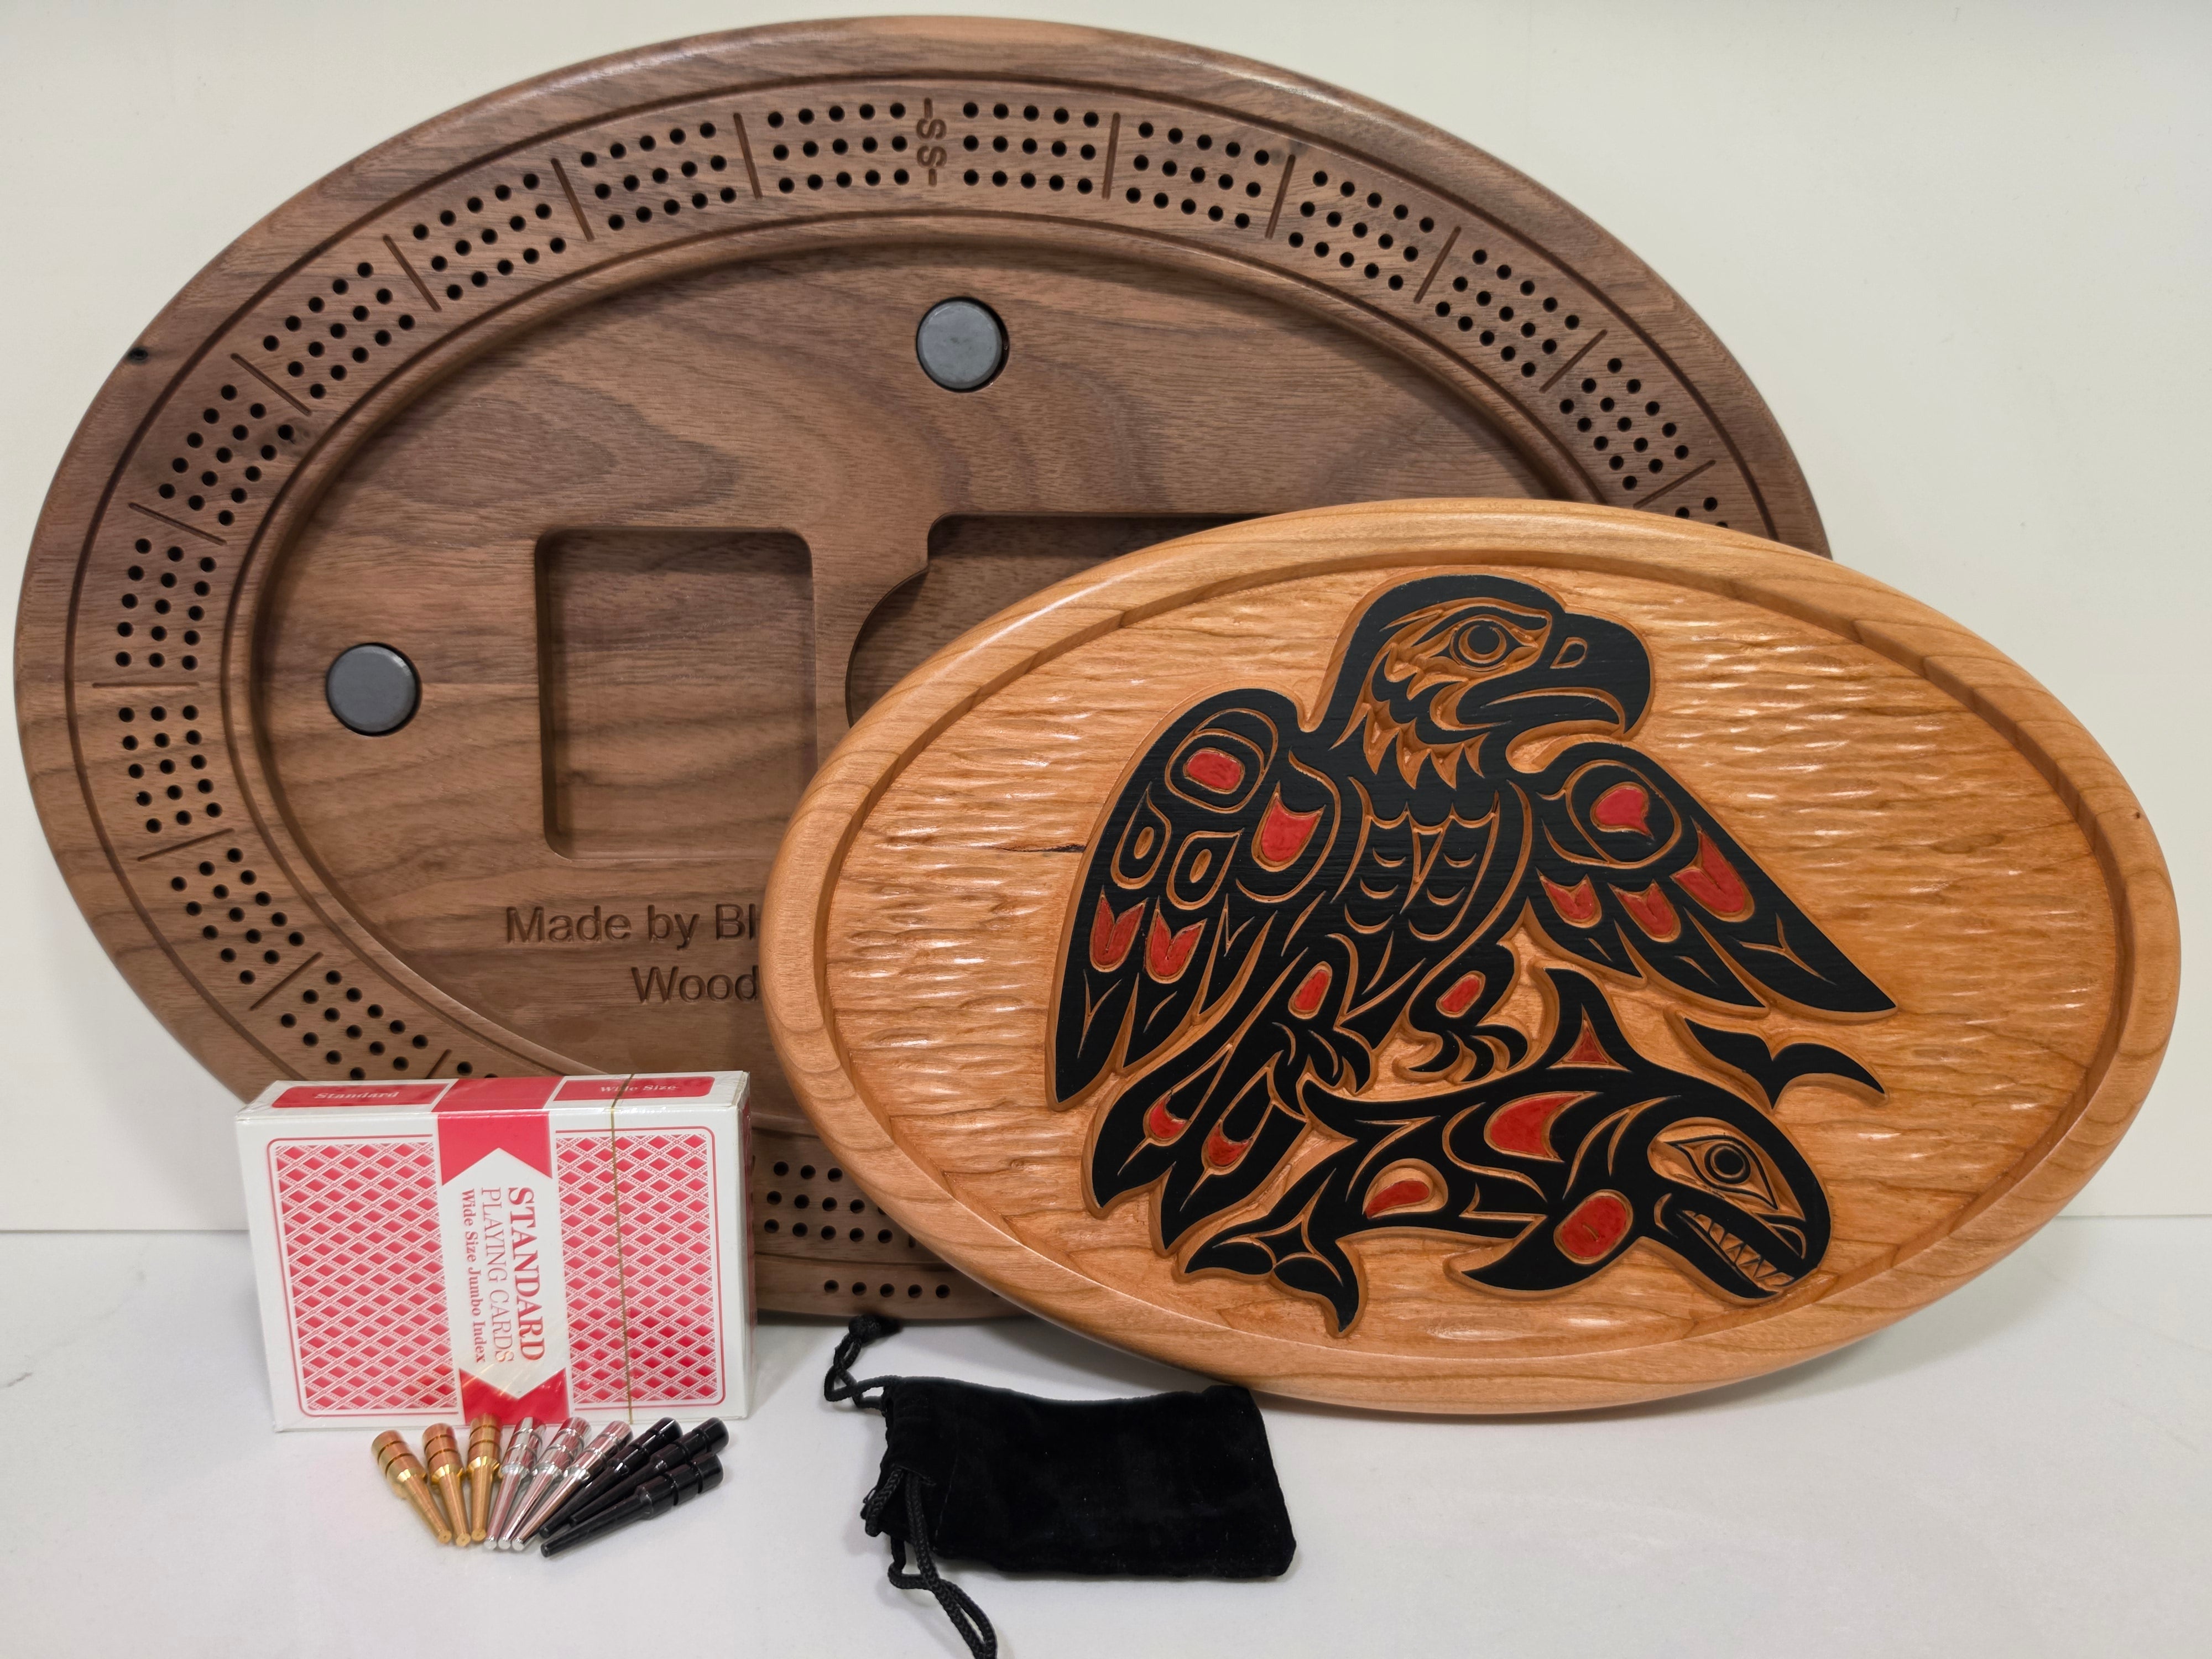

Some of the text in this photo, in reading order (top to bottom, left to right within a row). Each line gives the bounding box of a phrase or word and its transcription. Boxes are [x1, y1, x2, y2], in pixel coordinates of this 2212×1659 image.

[506, 903, 756, 951] Made by Bl
[630, 965, 759, 1004] Wood
[315, 1091, 400, 1099] Standard
[462, 1188, 487, 1363] Wide Size Jumbo Index
[481, 1187, 514, 1362] PLAYING CARDS
[508, 1187, 545, 1360] STANDARD
